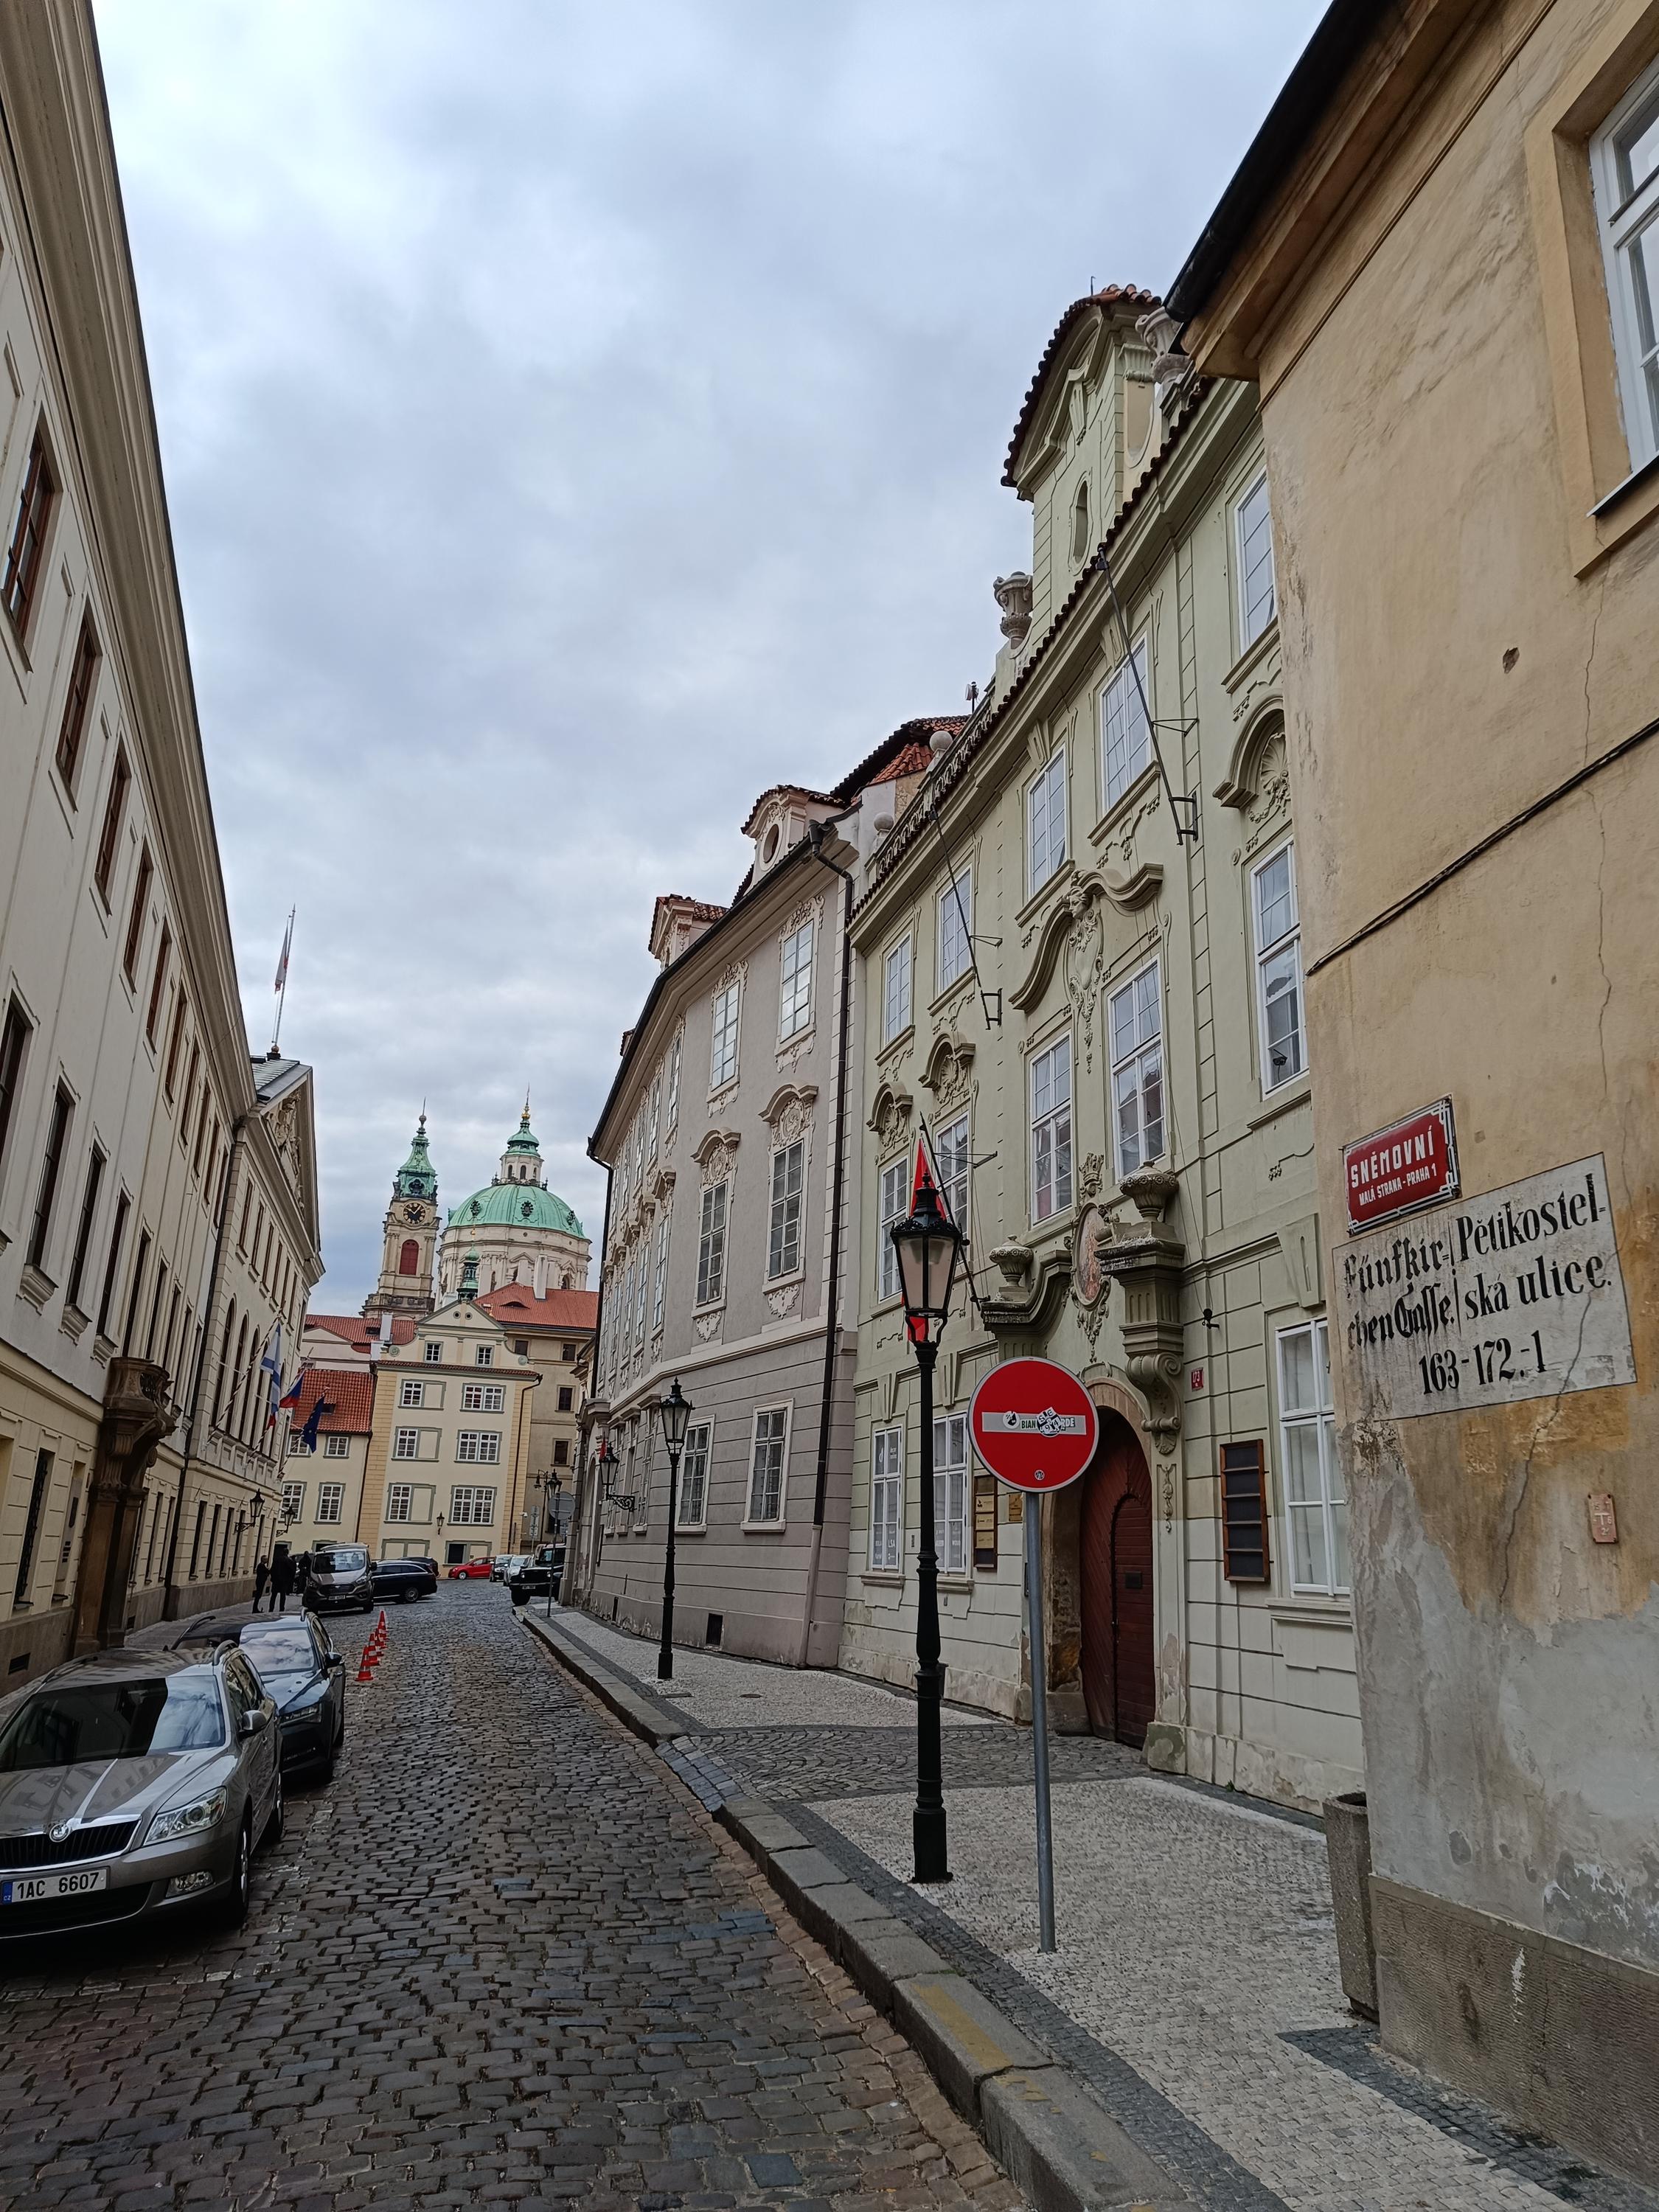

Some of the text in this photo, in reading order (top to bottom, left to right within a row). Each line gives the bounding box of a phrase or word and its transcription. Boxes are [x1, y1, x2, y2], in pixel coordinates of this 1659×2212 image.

[1358, 1185, 1376, 1206] MALÁ
[1377, 1177, 1402, 1198] STRANA
[1406, 1166, 1430, 1186] PRAHA
[1431, 1163, 1437, 1177] 1
[1464, 1255, 1612, 1321] ská ulice.
[17, 1872, 100, 1899] 1AC 6607
